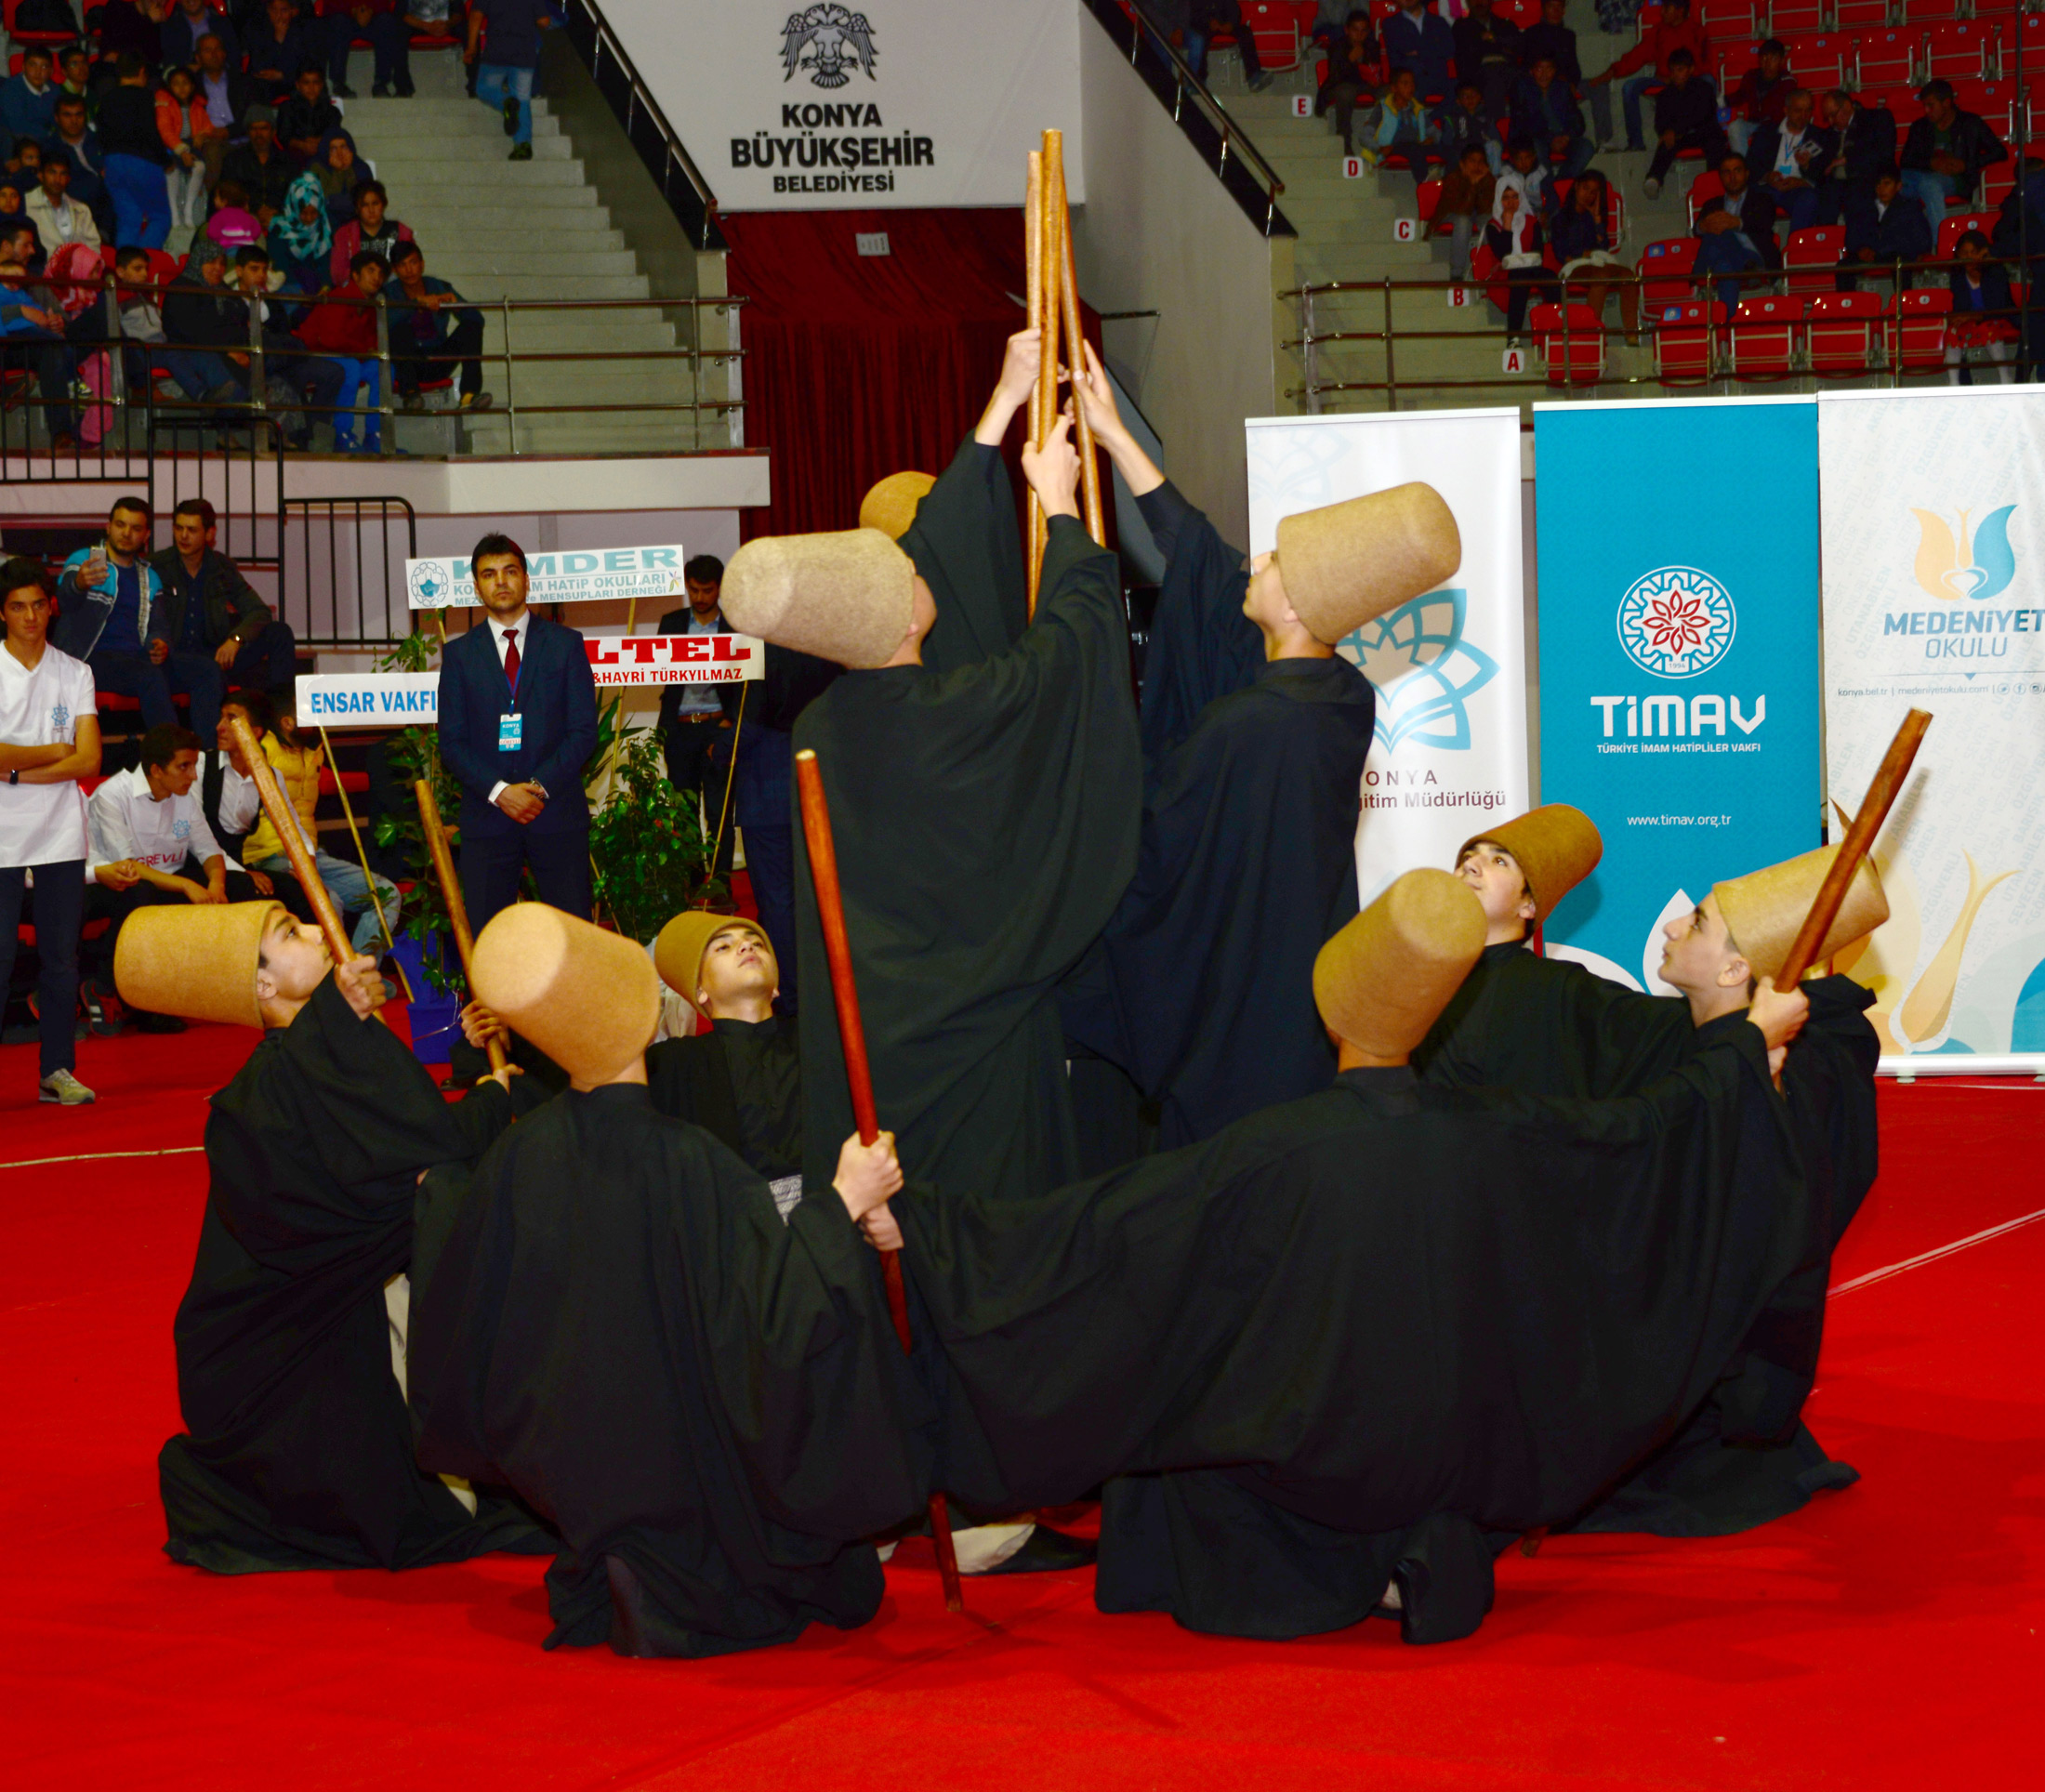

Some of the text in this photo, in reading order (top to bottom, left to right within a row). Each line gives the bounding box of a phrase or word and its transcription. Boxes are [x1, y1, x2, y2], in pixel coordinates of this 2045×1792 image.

[782, 103, 882, 128] KONYA
[1298, 99, 1306, 114] E
[731, 130, 935, 172] BÜYÜKŞEHİR
[1348, 161, 1358, 177] D
[773, 170, 894, 193] BELEDİYESİ
[1399, 221, 1409, 239] C
[1454, 288, 1464, 306] B
[1508, 352, 1519, 370] A
[453, 548, 679, 580] KMDER
[540, 589, 614, 602] MENSUPLARI
[1925, 637, 2008, 659] OKULU
[651, 667, 743, 682] TÜRKYILMAZ
[1838, 685, 1988, 697] konya.bel.tr medeniyetokulu.com
[311, 691, 437, 714] ENSAR VAKFI
[1596, 743, 1639, 754] TÜRKİYE
[1731, 743, 1761, 753] VAKFI
[1366, 770, 1438, 786] ONYA
[1405, 790, 1506, 810] Müdürlüğü
[1627, 814, 1732, 828] www.timav.org.tr
